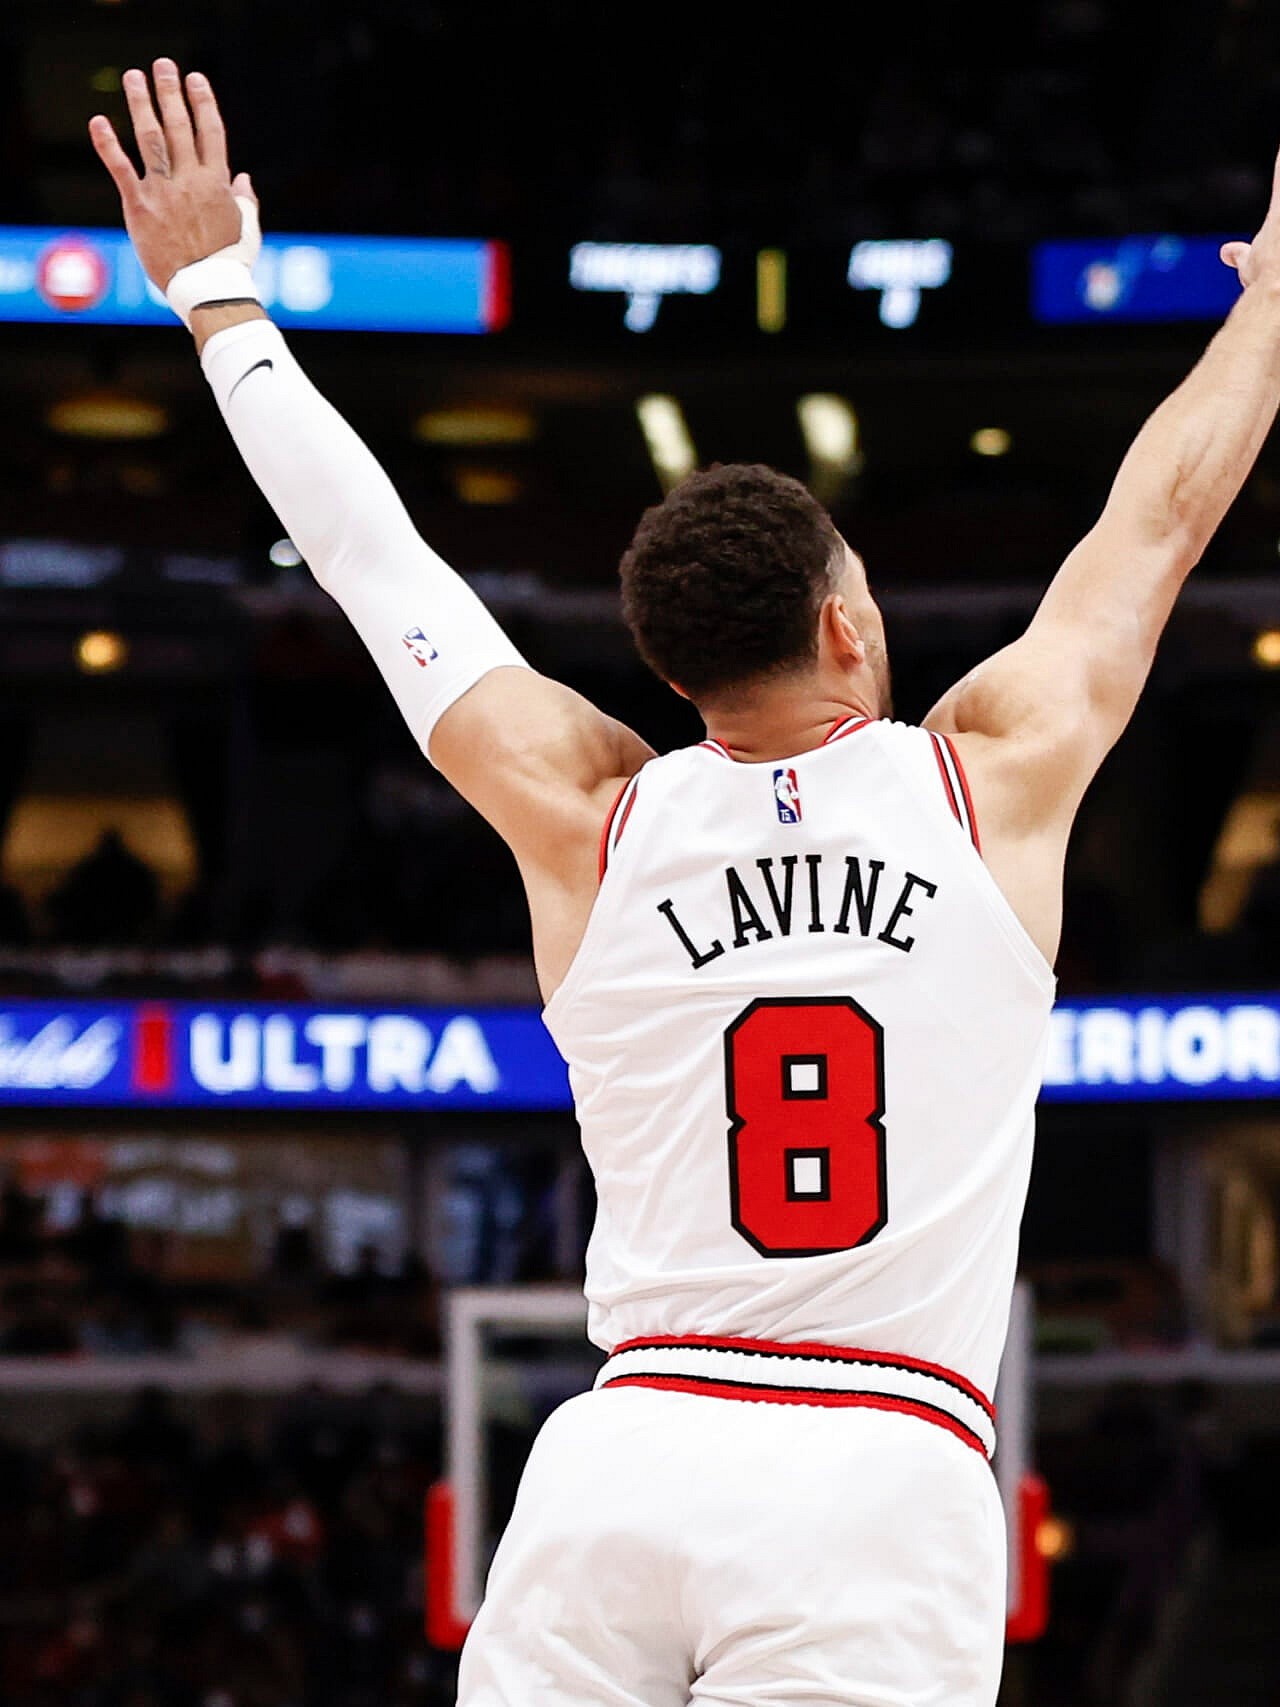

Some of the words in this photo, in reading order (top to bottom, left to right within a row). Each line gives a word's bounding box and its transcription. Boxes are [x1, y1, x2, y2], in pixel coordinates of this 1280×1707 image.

[657, 854, 938, 970] LAVINE
[190, 1013, 499, 1093] ULTRA
[723, 996, 889, 1258] 8
